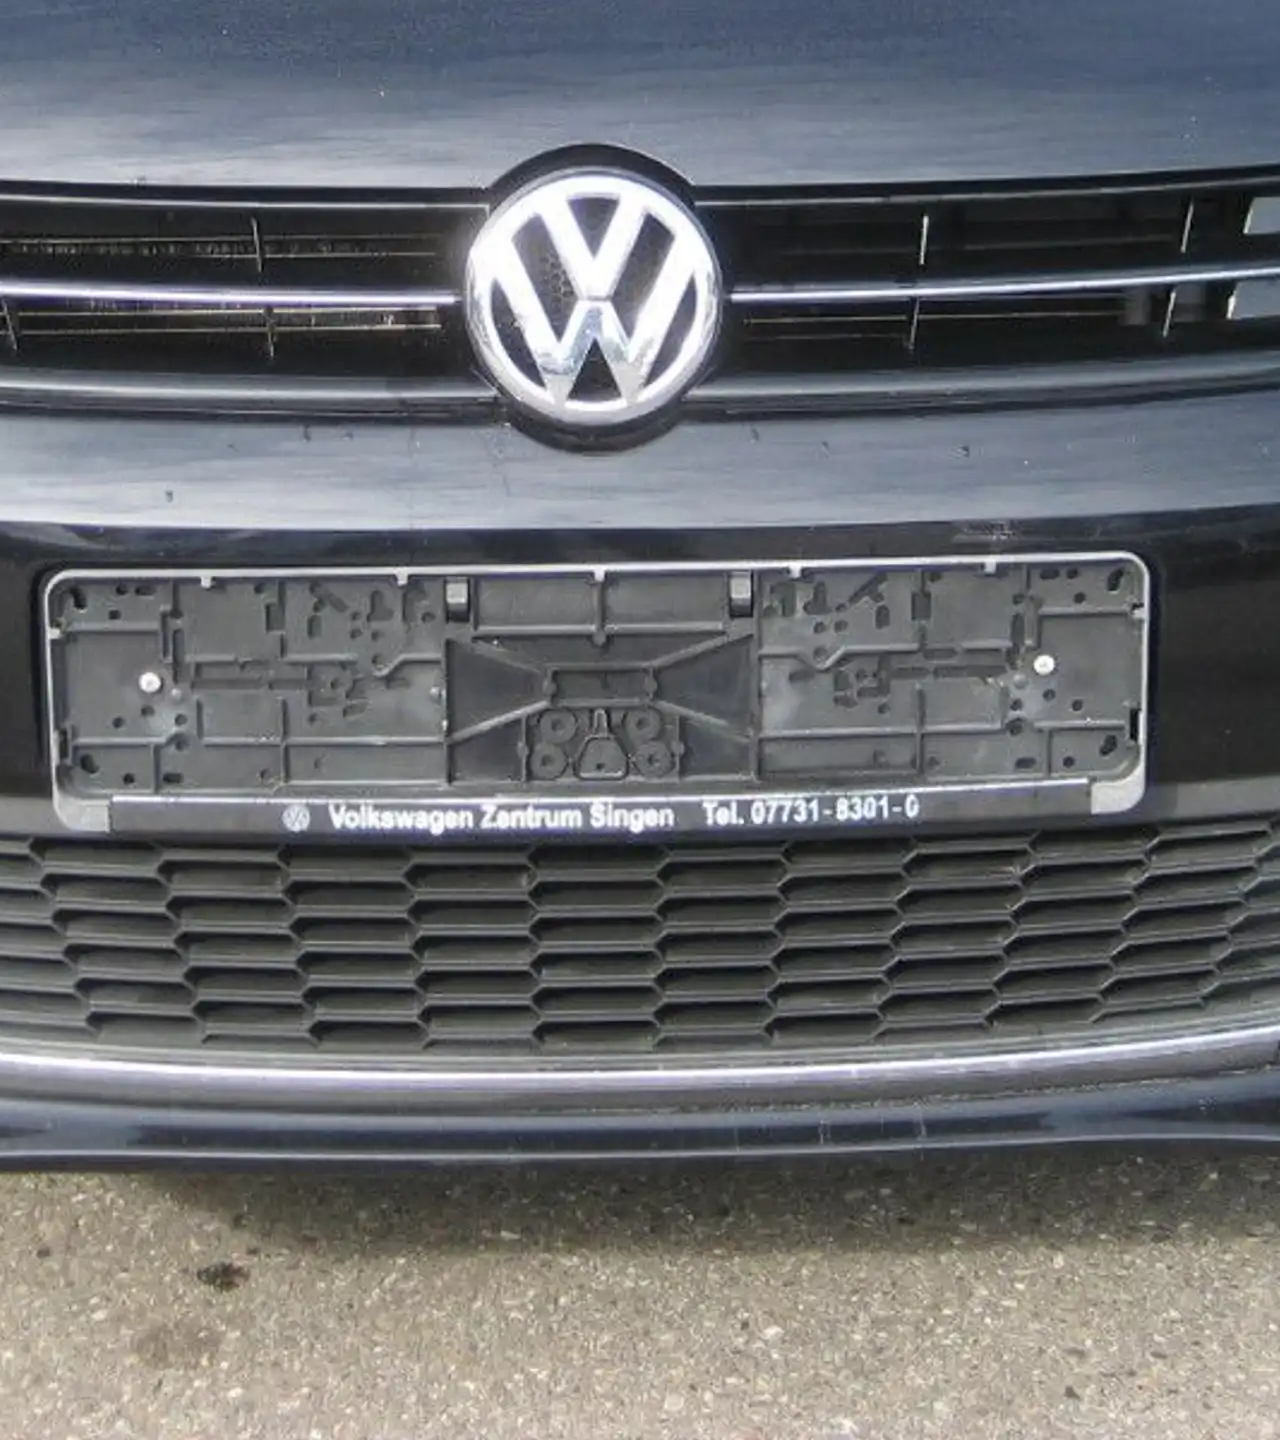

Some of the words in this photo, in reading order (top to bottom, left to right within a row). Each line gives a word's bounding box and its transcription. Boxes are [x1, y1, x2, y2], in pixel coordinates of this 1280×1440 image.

[328, 804, 474, 835] Volkswagen
[481, 804, 583, 828] Zentrum
[590, 800, 674, 833] Singen
[701, 801, 744, 826] Tel.
